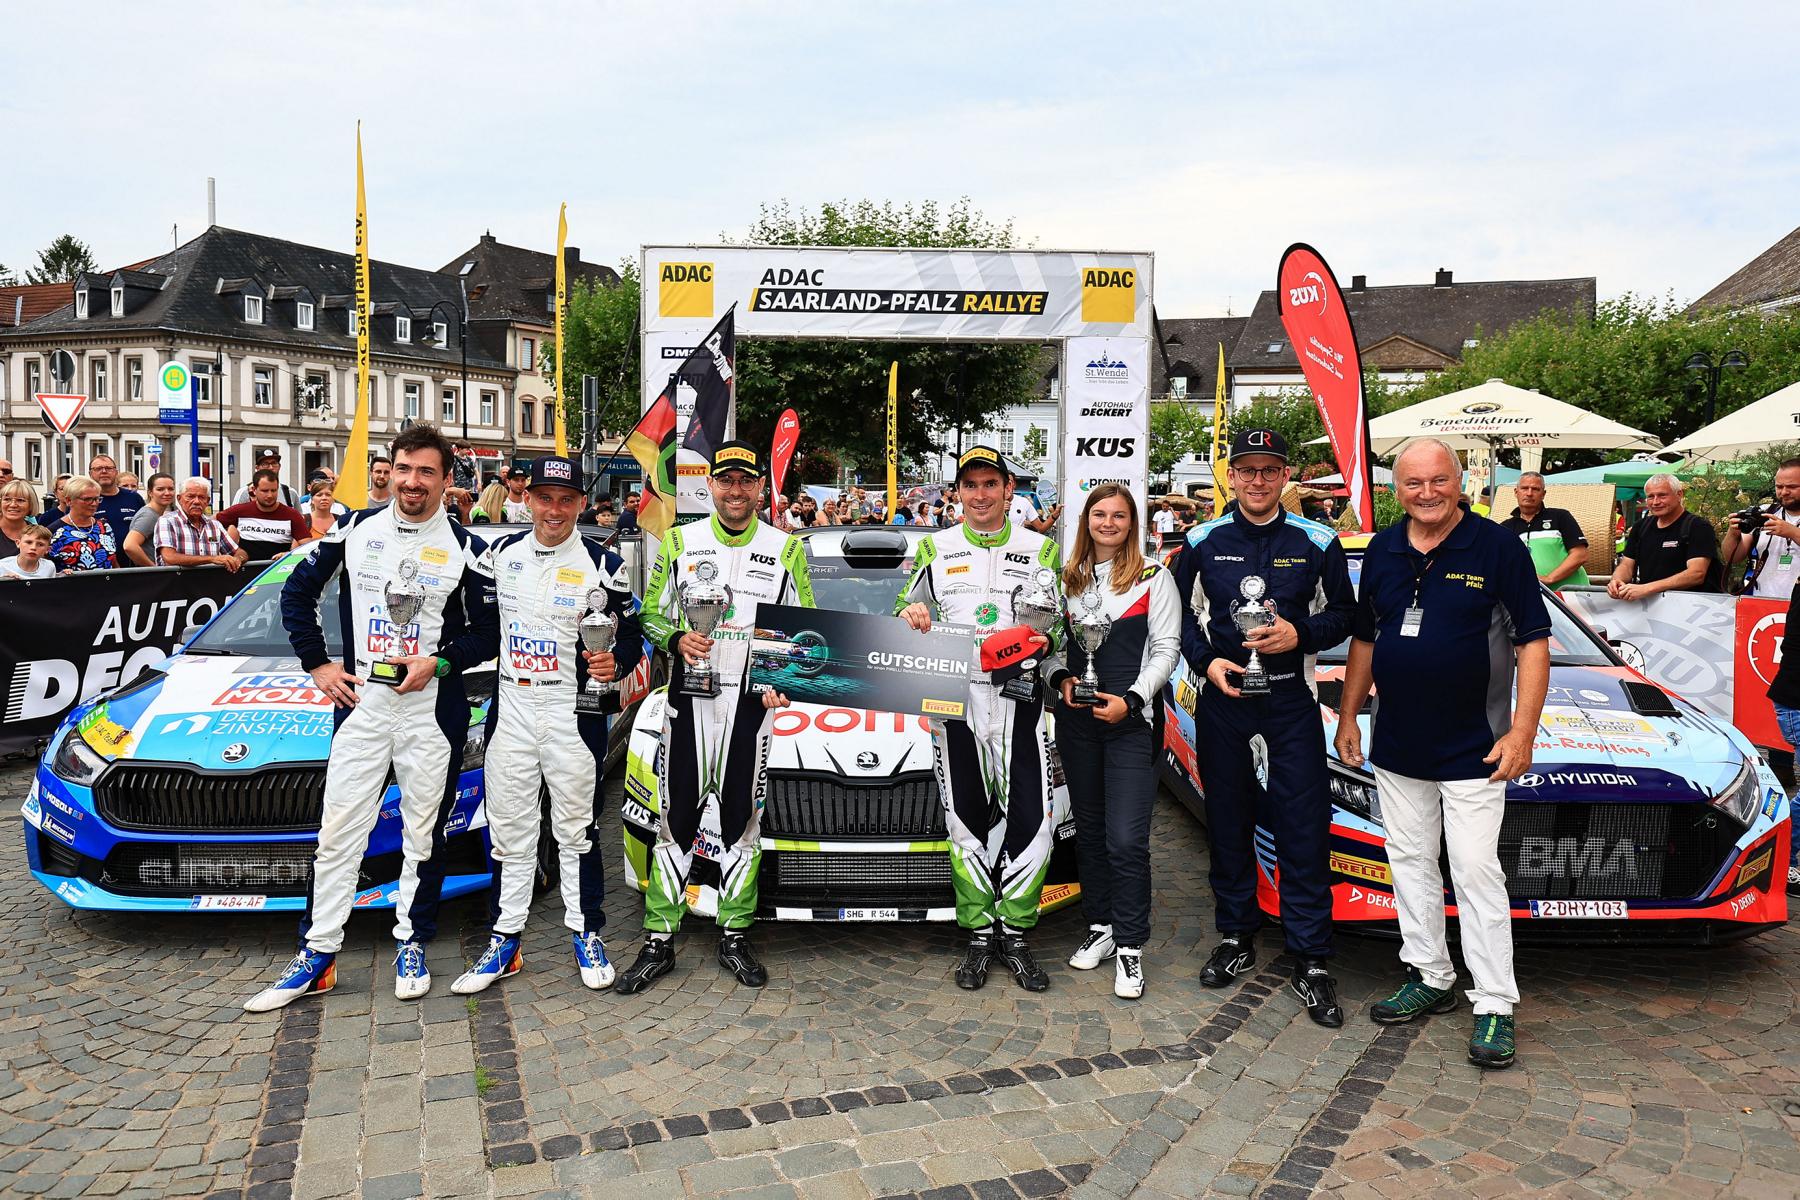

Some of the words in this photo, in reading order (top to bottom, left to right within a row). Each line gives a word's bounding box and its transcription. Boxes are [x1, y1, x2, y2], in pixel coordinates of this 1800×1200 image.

[662, 265, 712, 282] ADAC
[760, 268, 824, 287] ADAC
[1085, 271, 1133, 288] ADAC
[759, 291, 958, 312] SAARLAND-PFALZ
[962, 294, 1043, 313] RALLYE
[664, 349, 695, 357] DMS
[1080, 408, 1132, 417] DECKERT
[1075, 437, 1136, 458] KÜS
[546, 462, 571, 471] LIQUI
[545, 470, 570, 479] MOLY
[240, 525, 286, 535] JACK&JONES
[1312, 530, 1329, 543] OMP
[750, 553, 776, 567] KÜS
[943, 551, 972, 560] SKODA
[1004, 552, 1031, 565] KÜS
[416, 575, 441, 586] ZSB
[1465, 580, 1484, 589] Pfalz
[1466, 574, 1484, 582] Team
[553, 596, 576, 606] ZSB
[730, 588, 768, 599] rive-Market.de
[92, 596, 232, 646] AUTO
[368, 637, 419, 655] MOY
[510, 636, 556, 656] LIQUI
[996, 643, 1023, 661] KÜS
[510, 652, 557, 672] MOLY
[867, 651, 969, 675] GUTSCHEIN
[20, 645, 186, 723] DEC
[237, 675, 316, 688] LIQU
[219, 689, 329, 704] MOLY
[924, 702, 961, 715] PIRELLI
[220, 711, 335, 725] DEUTSCHE
[211, 722, 333, 737] ZINSHAUS
[629, 776, 651, 797] RAVENOL
[1548, 772, 1638, 786] HYUNDAI
[46, 791, 72, 816] MOSOLF
[621, 799, 651, 825] KÜS
[1332, 860, 1376, 880] IRELLI
[1366, 893, 1398, 910] DEKR
[1543, 901, 1623, 917] 2-DHY-103
[1738, 893, 1755, 911] DEKRA
[846, 910, 864, 918] SHG
[871, 910, 877, 918] R
[879, 910, 896, 918] 544
